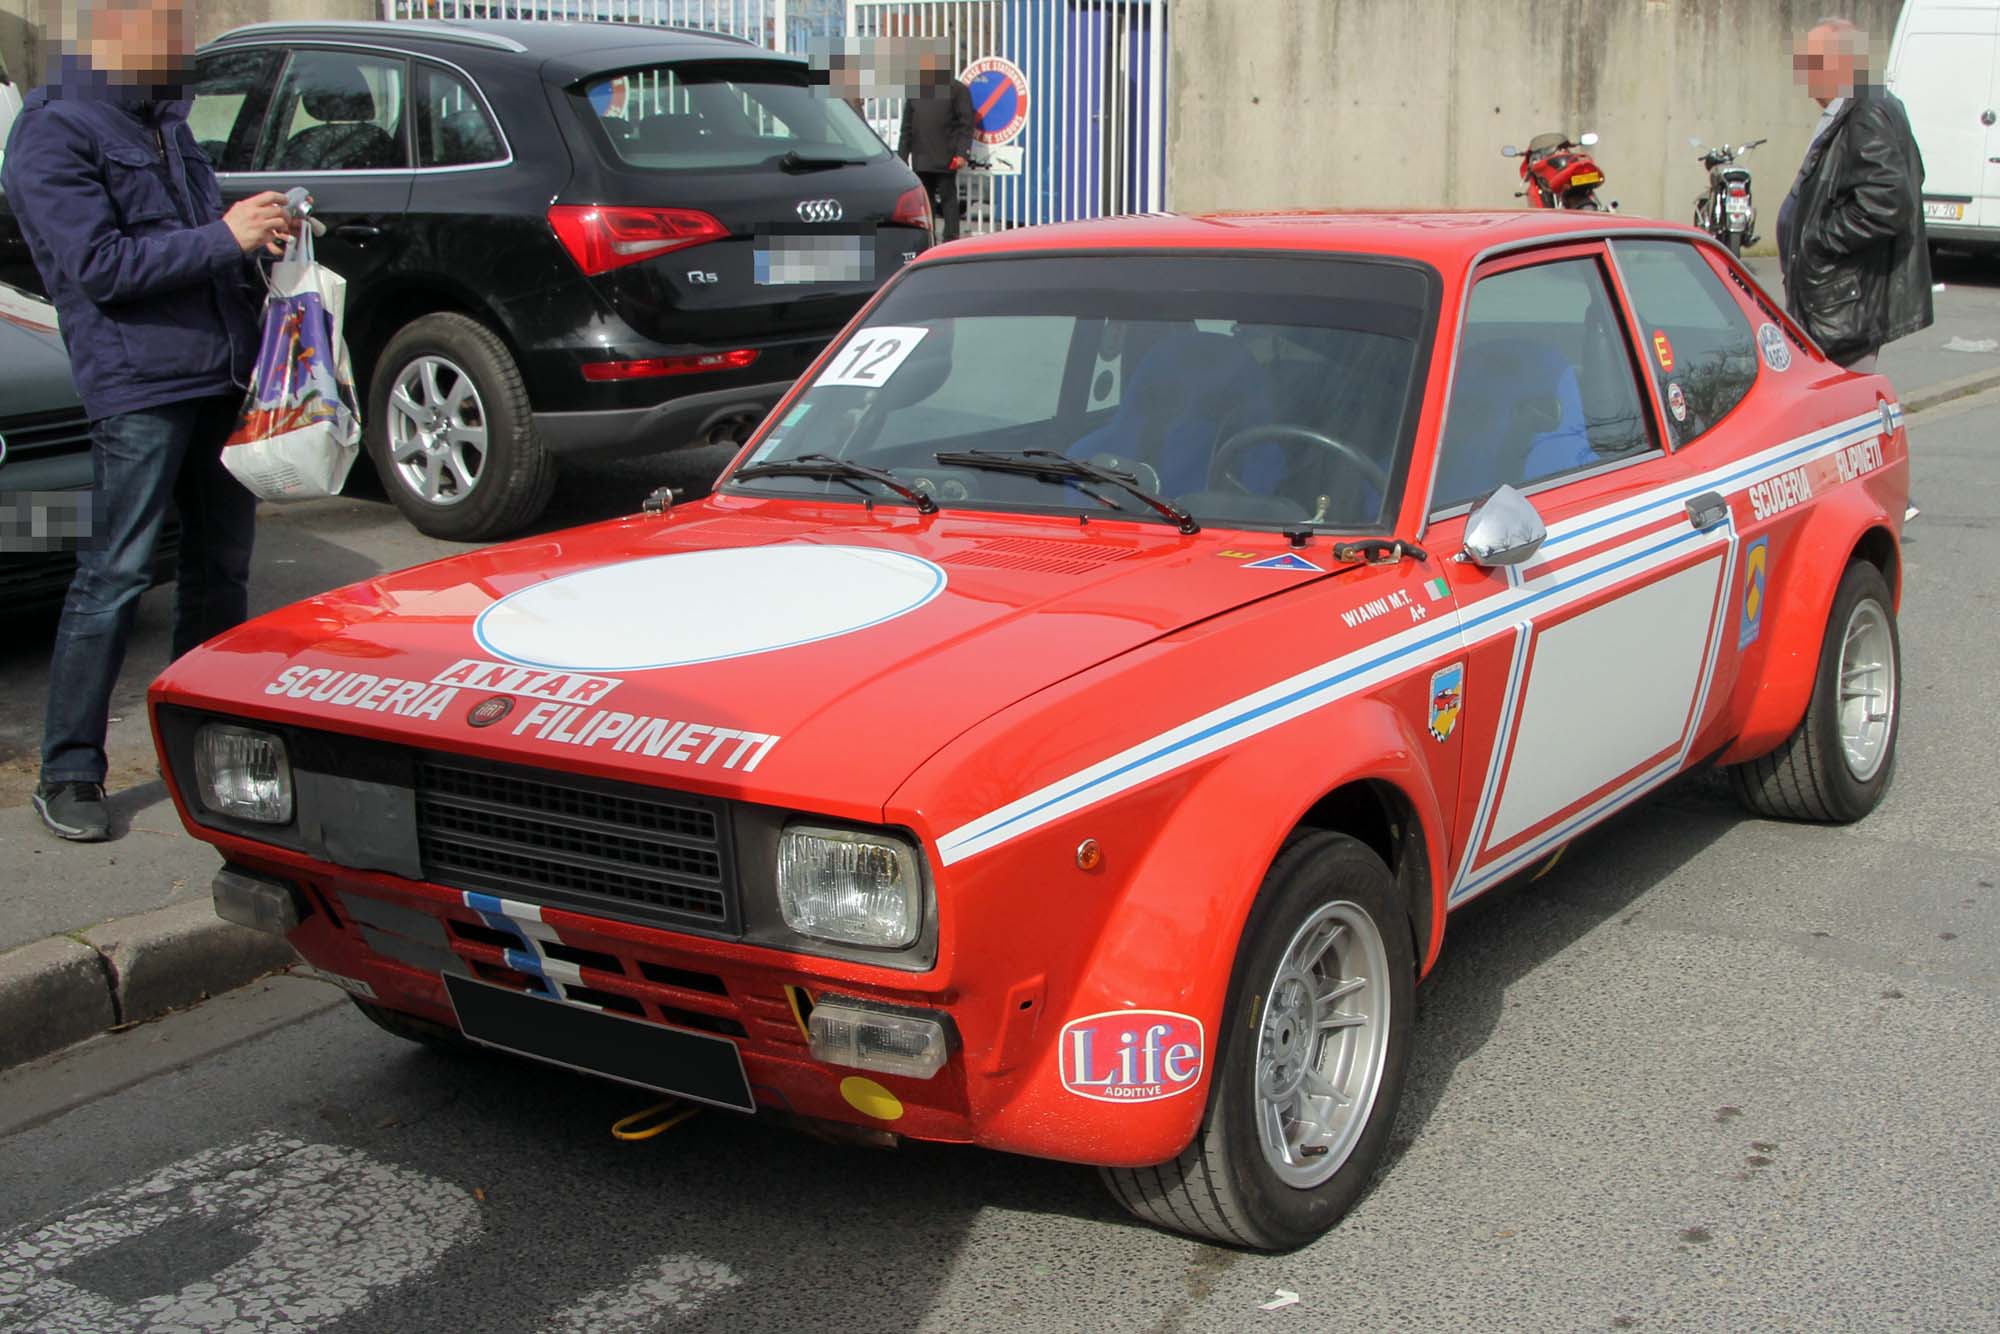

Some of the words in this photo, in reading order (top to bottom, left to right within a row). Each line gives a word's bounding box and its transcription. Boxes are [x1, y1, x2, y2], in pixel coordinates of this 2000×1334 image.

[838, 338, 902, 379] 12
[1654, 336, 1672, 367] E
[1749, 467, 1812, 521] SCUDERIA
[1836, 438, 1883, 484] FILIPINETTI
[1341, 597, 1390, 628] WIANNI
[1410, 604, 1427, 622] A+
[264, 665, 459, 721] SCUDERIA
[439, 662, 612, 702] ANTAR
[511, 701, 781, 772] FILIPINETTI
[1068, 1024, 1201, 1086] Life
[1103, 1085, 1162, 1097] ADDITIVE
